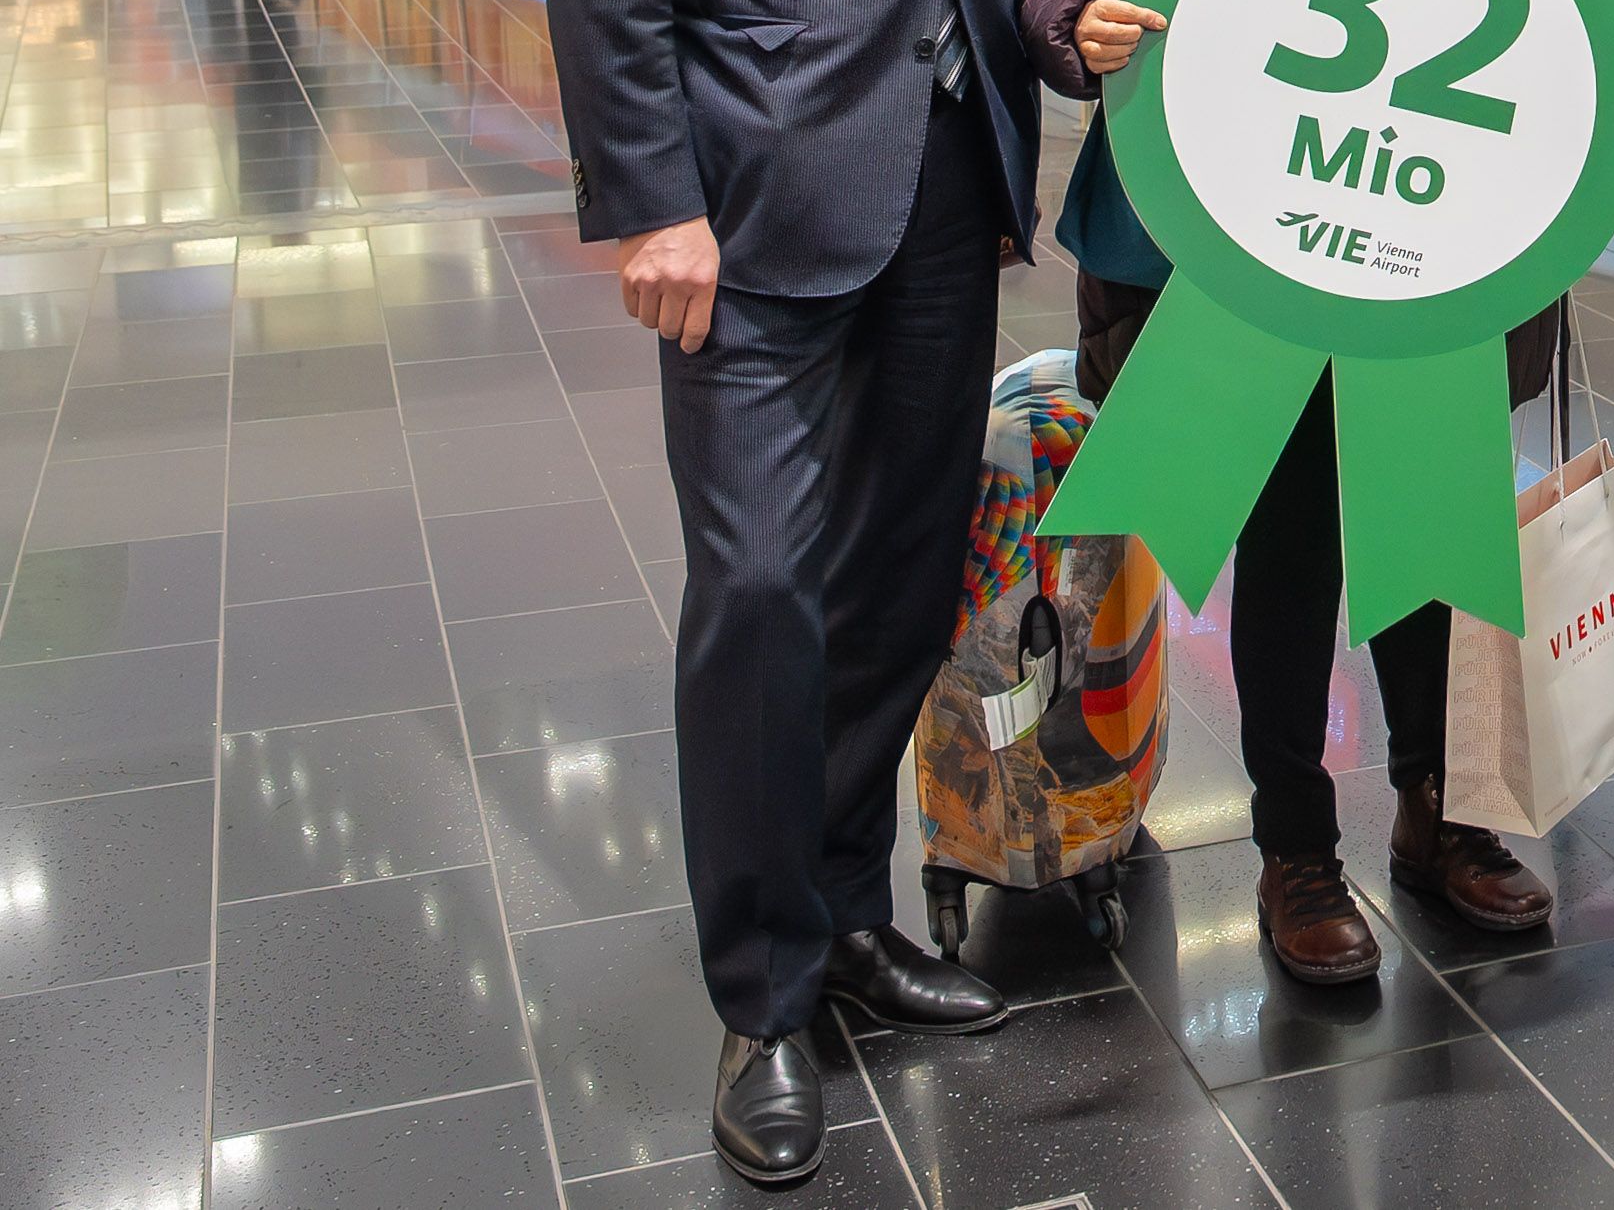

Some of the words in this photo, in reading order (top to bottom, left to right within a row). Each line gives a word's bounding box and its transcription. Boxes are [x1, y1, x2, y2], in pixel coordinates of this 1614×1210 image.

[1287, 114, 1446, 205] Mio
[1298, 216, 1373, 265] VIE
[1377, 240, 1424, 262] Vienna
[1370, 257, 1421, 278] Airport
